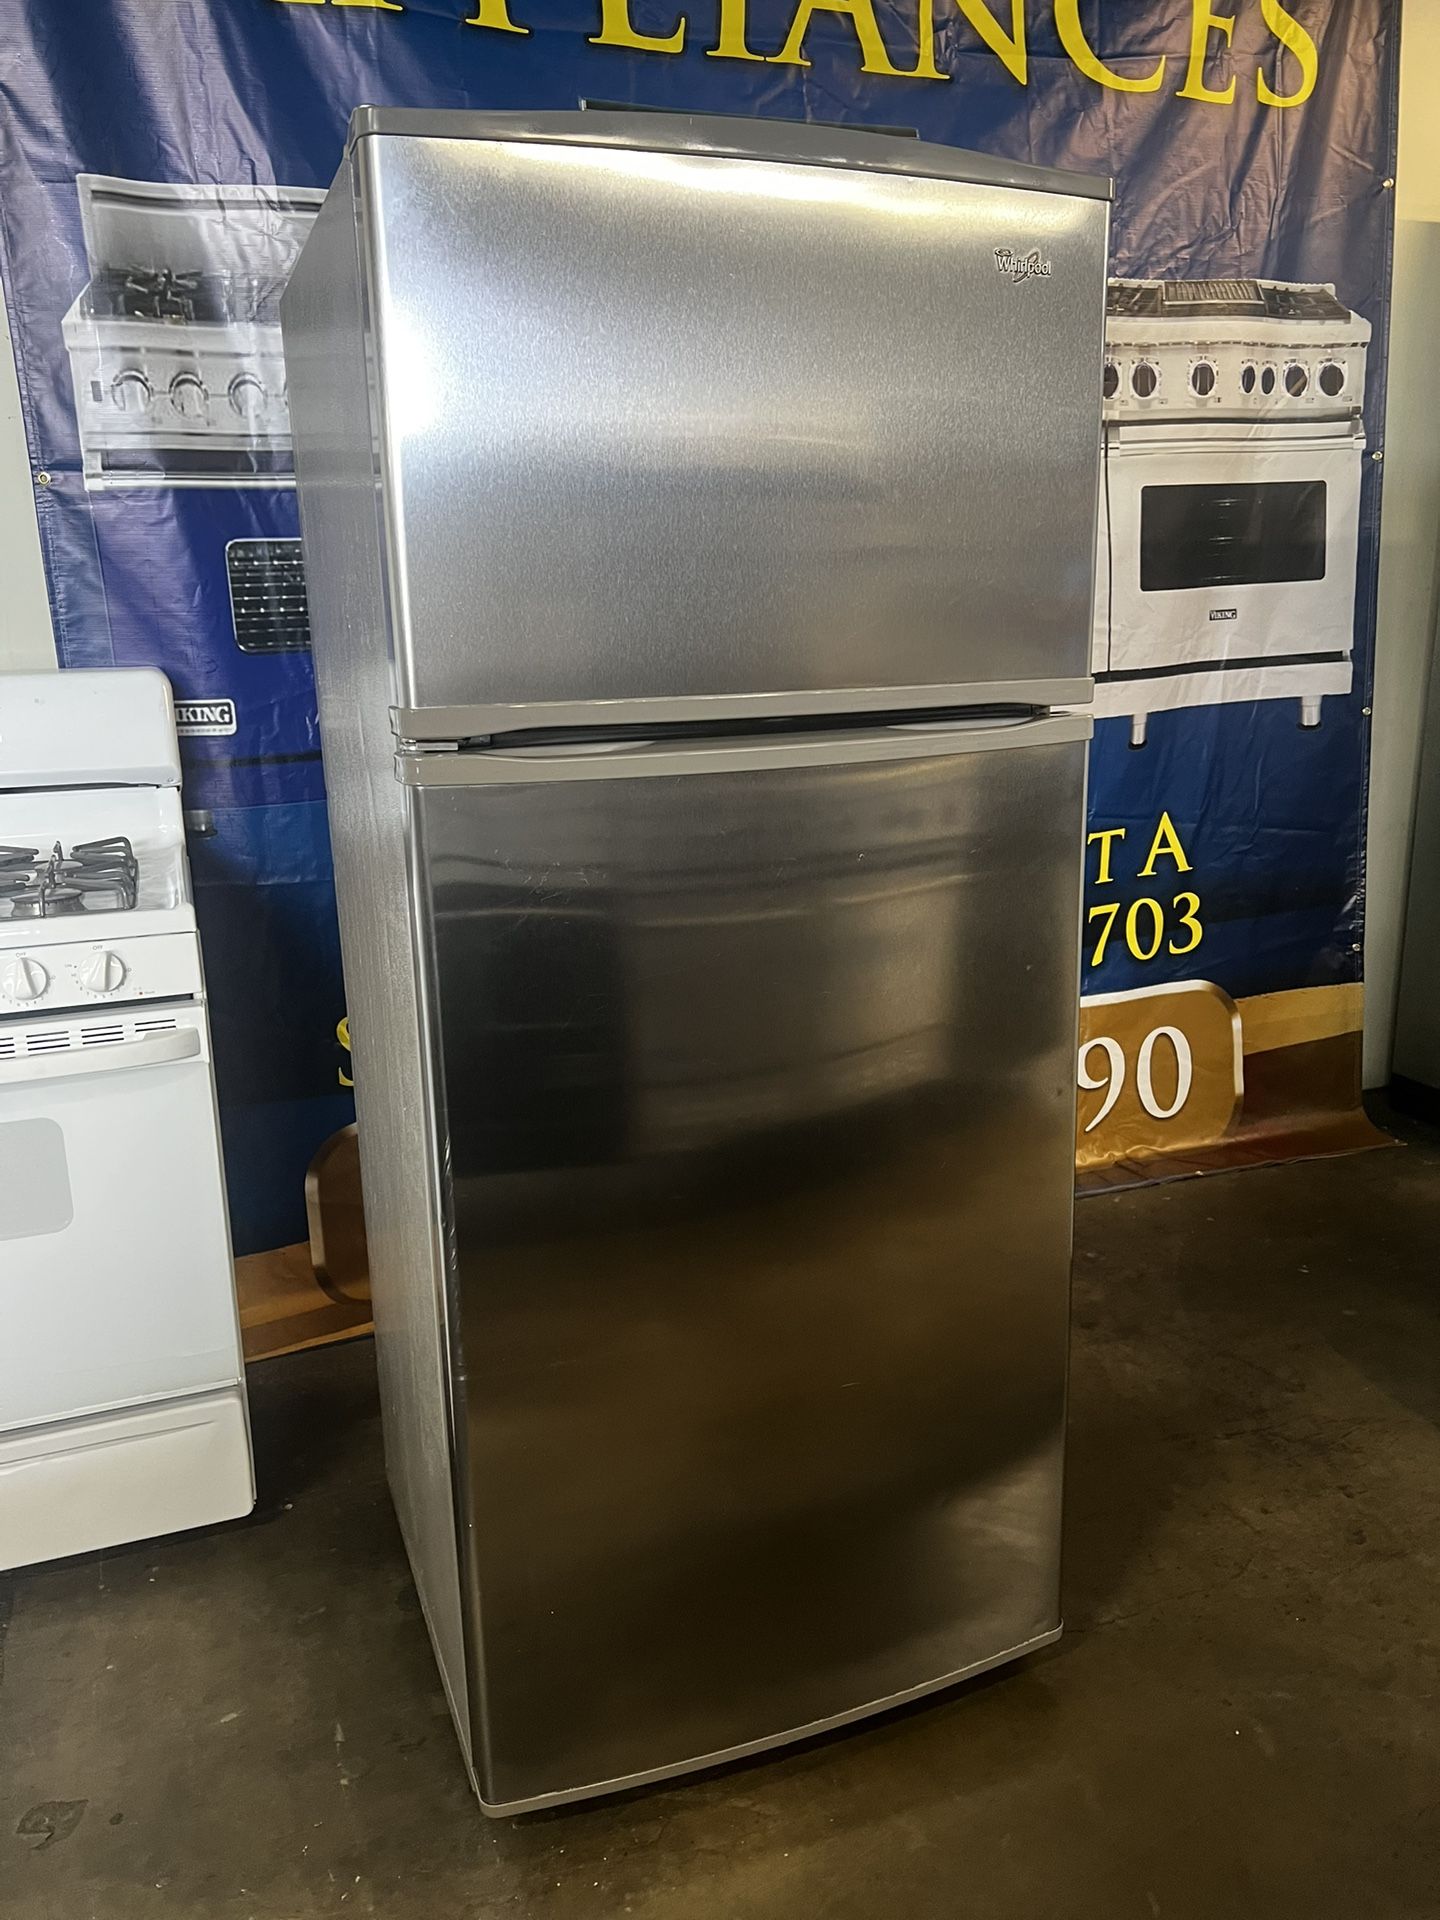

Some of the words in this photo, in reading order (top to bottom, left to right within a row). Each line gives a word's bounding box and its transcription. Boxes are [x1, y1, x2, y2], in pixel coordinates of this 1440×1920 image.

[996, 250, 1052, 281] Whirlpool
[175, 706, 230, 722] IKING
[1137, 811, 1193, 877] A
[1088, 892, 1203, 967] 703
[1077, 1026, 1192, 1132] 90
